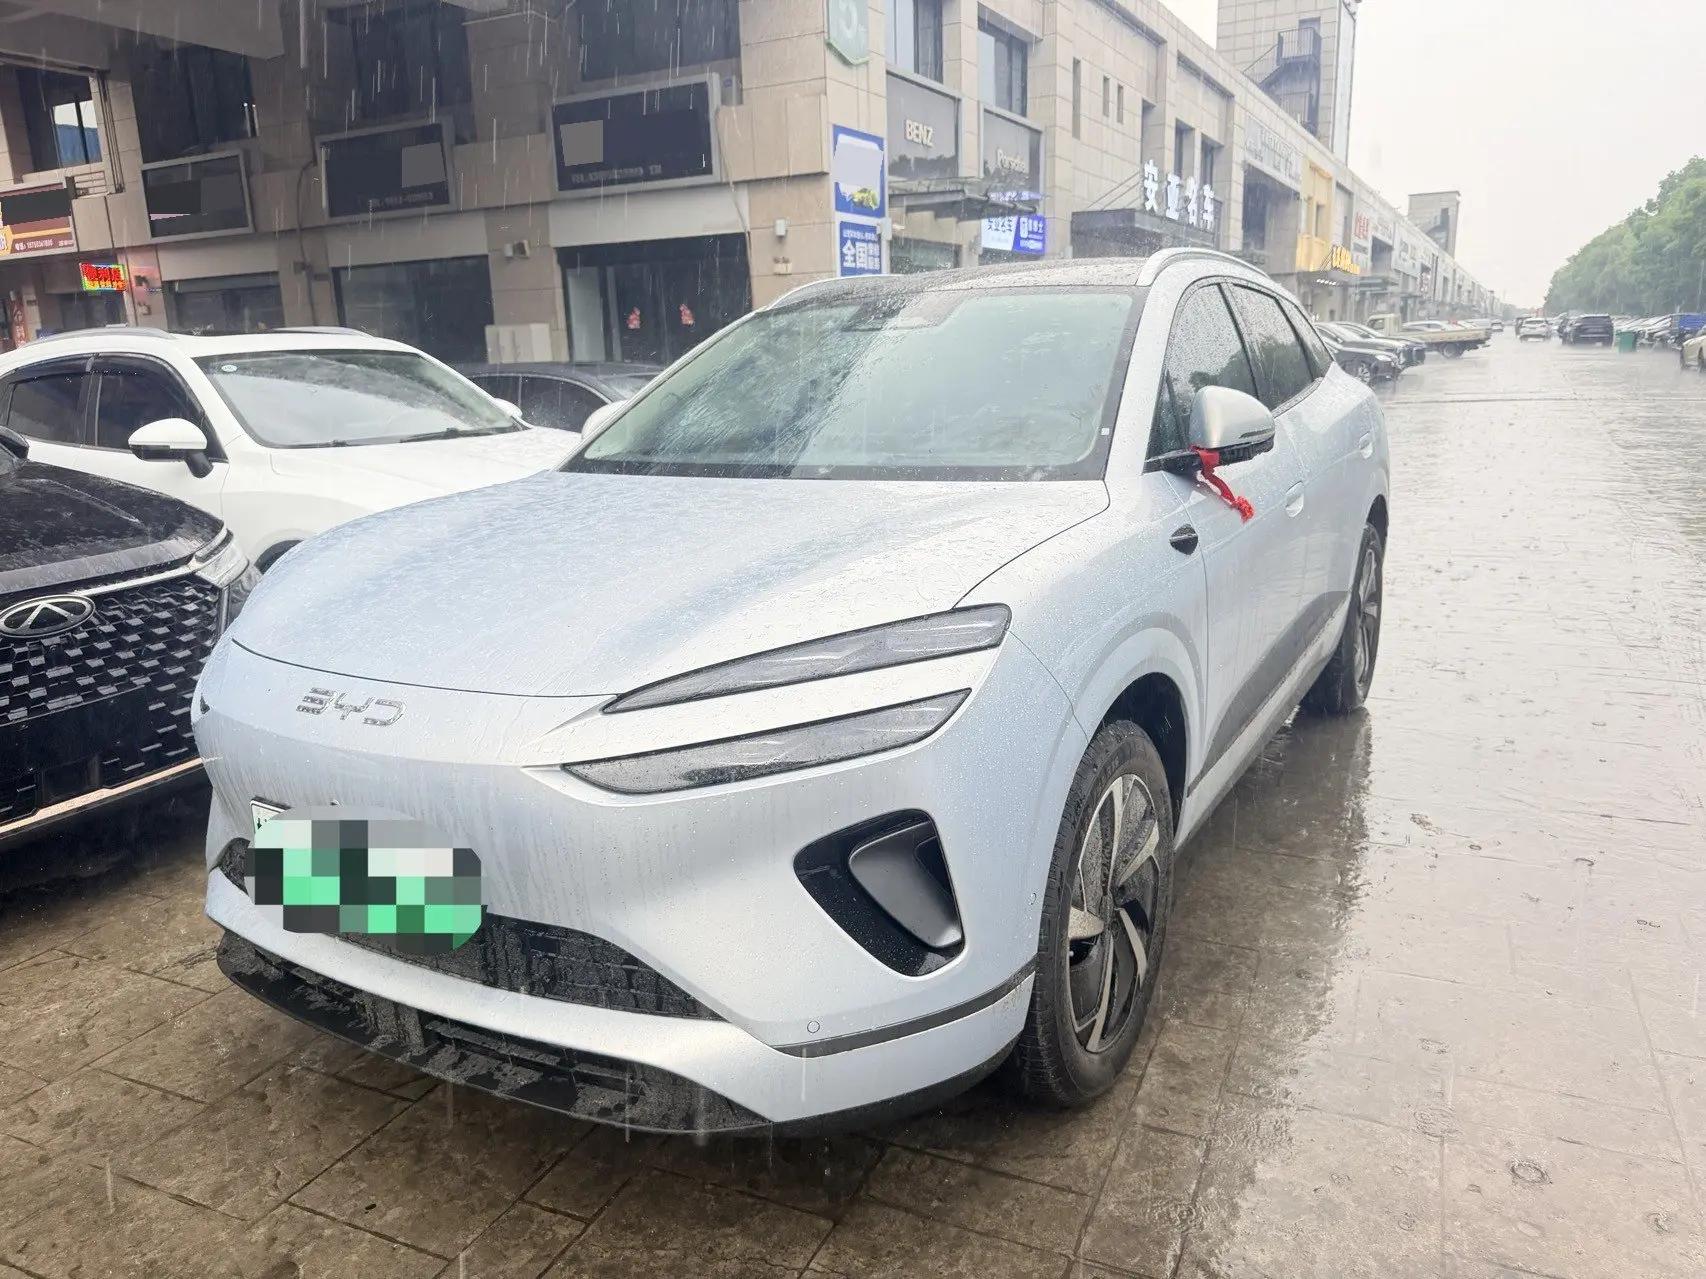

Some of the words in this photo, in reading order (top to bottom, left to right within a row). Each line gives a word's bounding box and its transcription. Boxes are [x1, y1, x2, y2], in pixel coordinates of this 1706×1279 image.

[905, 119, 934, 148] BENZ
[1143, 158, 1215, 231] 安亚名车
[296, 688, 406, 727] BYD
